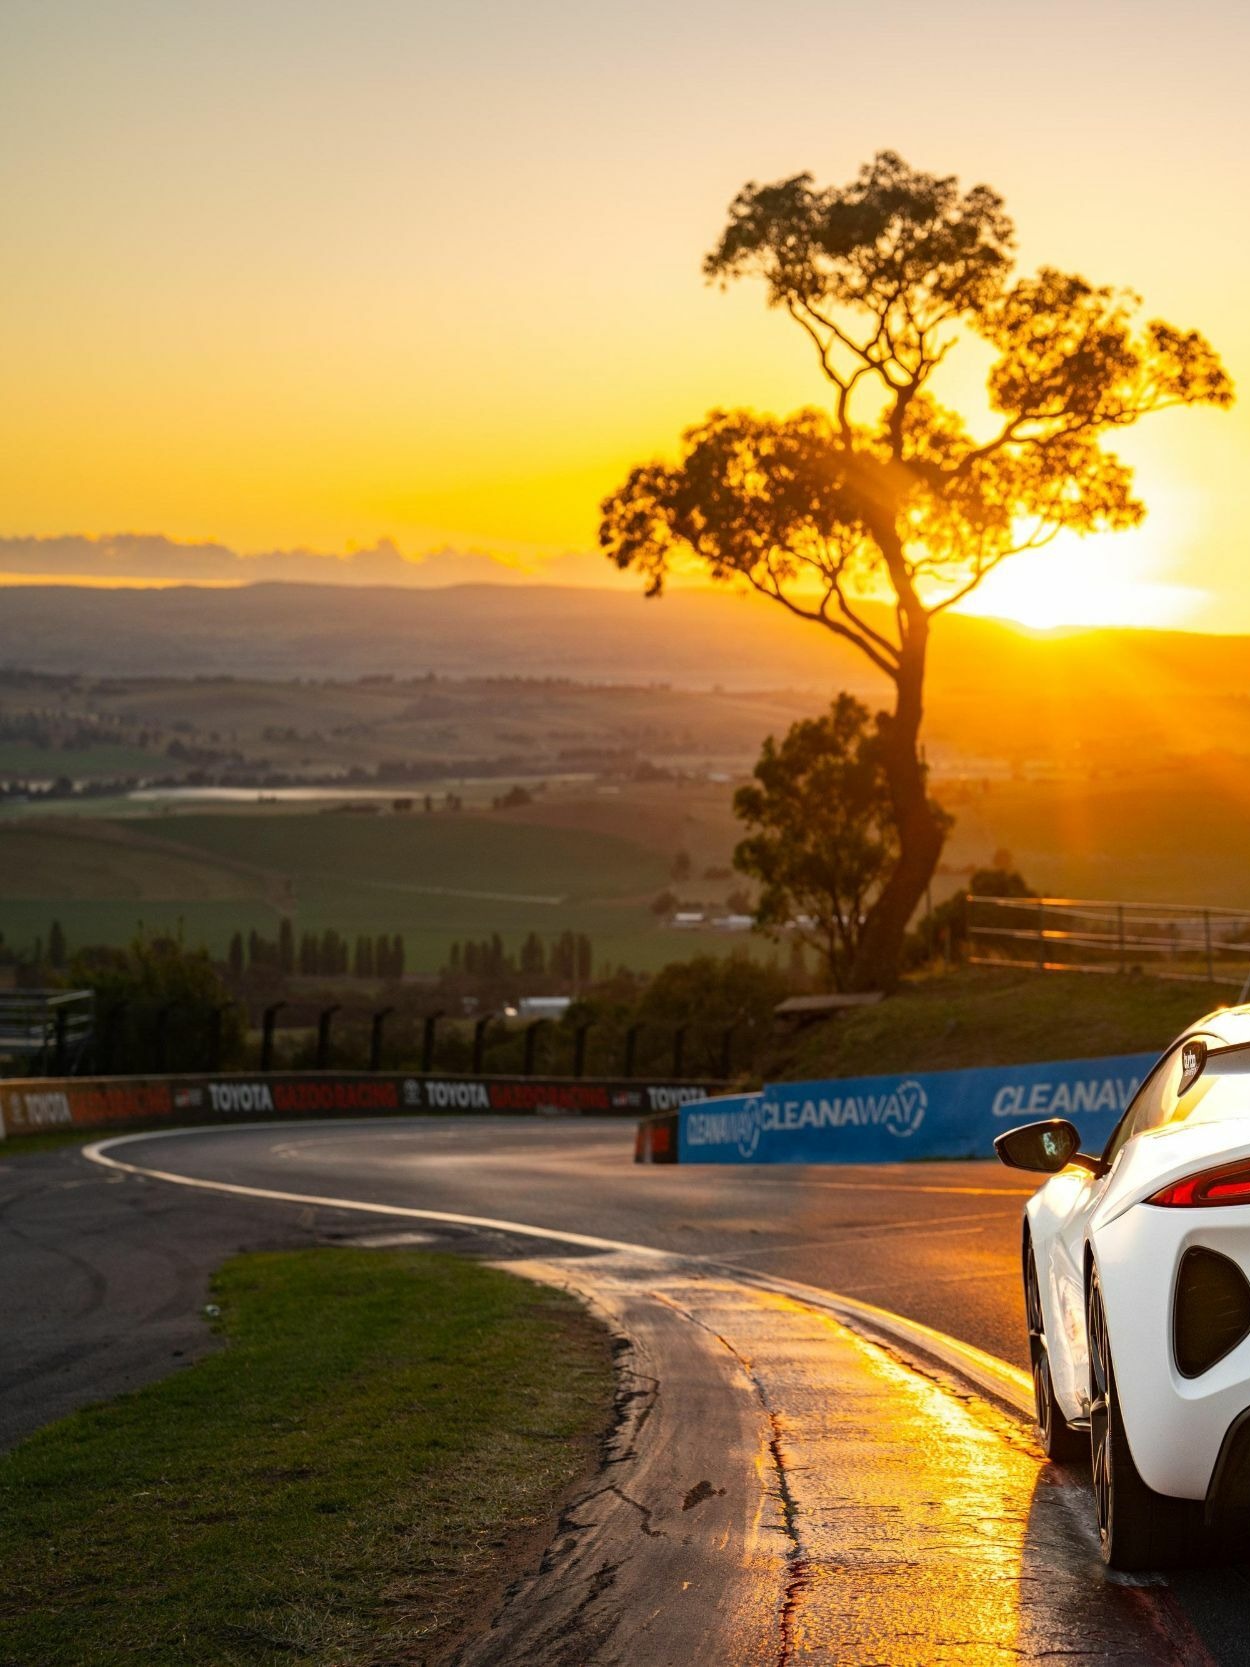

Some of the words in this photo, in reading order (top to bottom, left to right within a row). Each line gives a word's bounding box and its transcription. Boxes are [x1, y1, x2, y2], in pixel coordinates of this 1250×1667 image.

[209, 1083, 274, 1112] TOYOTA
[425, 1081, 490, 1108] TOYOTA
[761, 1094, 917, 1131] CLEANAWAY
